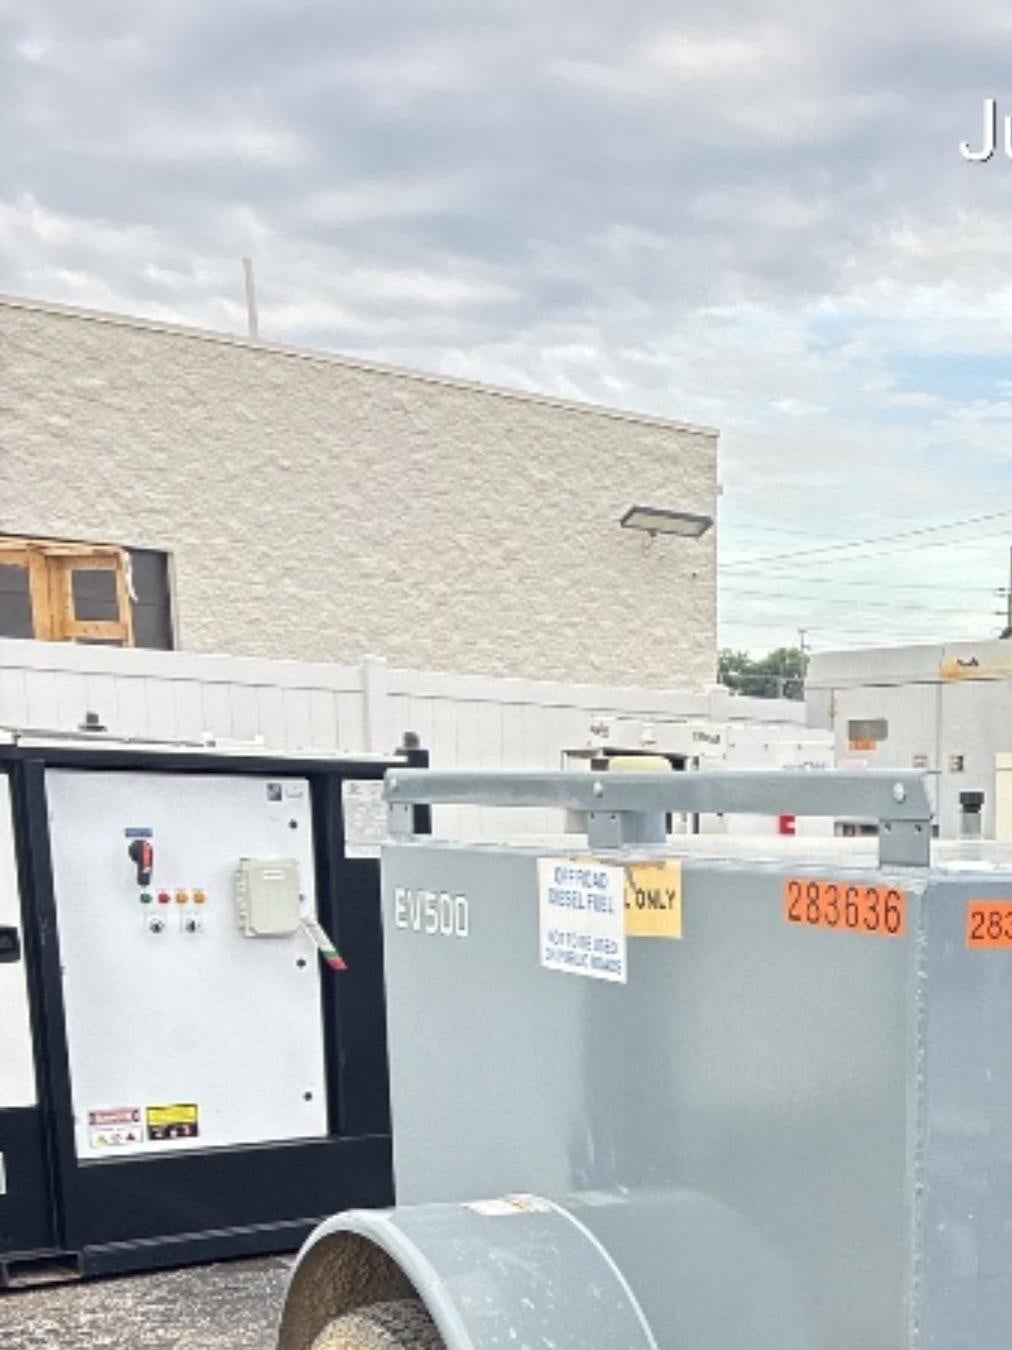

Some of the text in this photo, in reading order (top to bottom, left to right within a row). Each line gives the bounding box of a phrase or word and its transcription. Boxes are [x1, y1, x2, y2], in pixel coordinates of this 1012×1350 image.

[394, 887, 470, 938] EV500
[635, 887, 677, 911] ONLY
[787, 880, 902, 935] 283636
